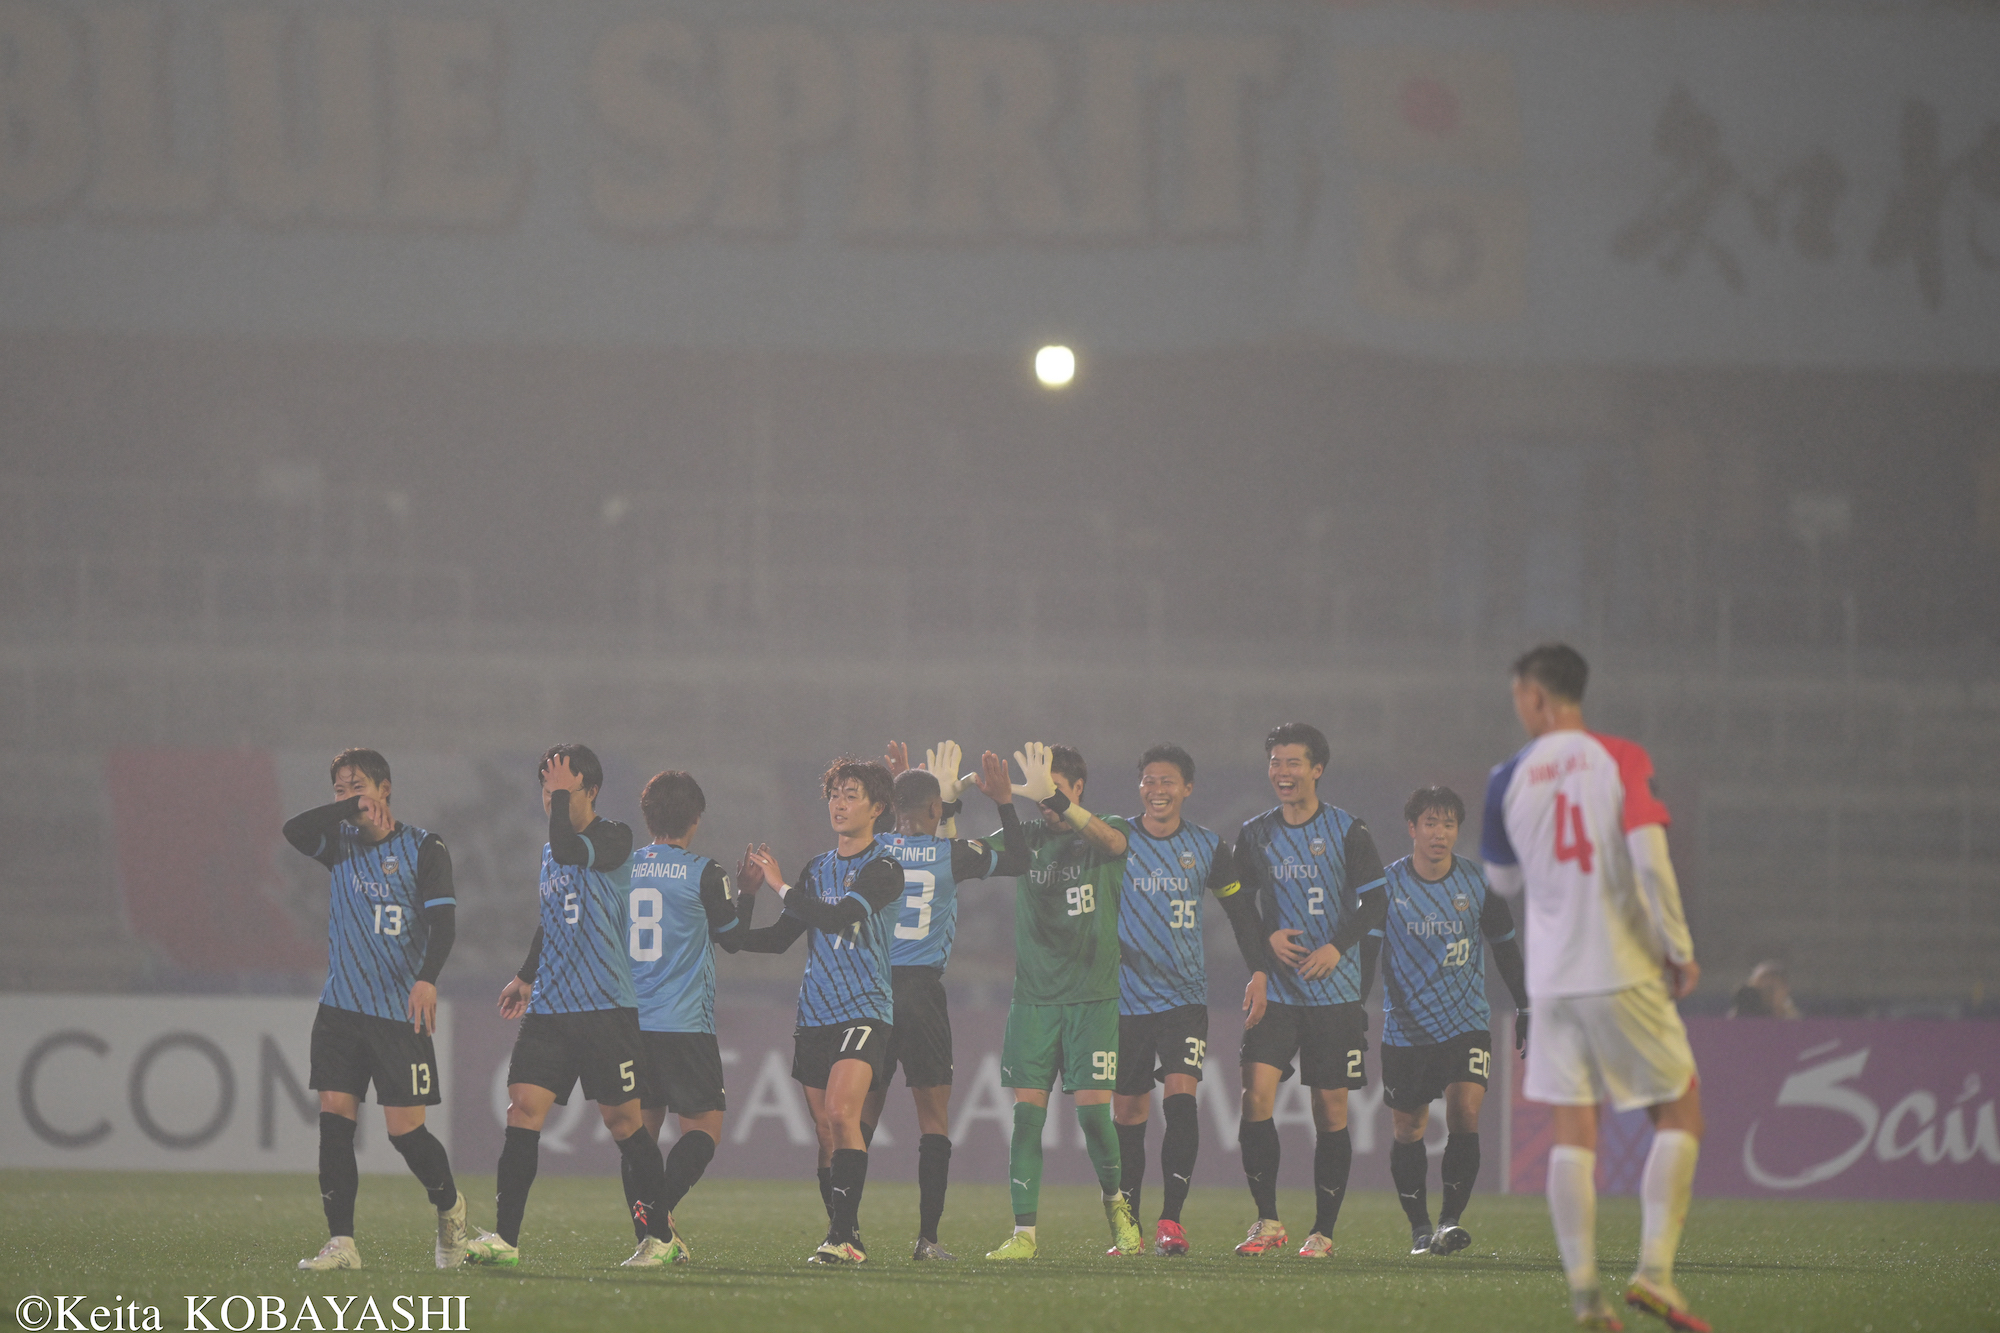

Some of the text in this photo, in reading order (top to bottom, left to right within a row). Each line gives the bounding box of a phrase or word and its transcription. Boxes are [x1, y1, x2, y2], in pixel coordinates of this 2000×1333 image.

[586, 18, 1298, 245] SPIRIT
[1554, 792, 1594, 874] 4
[630, 862, 687, 880] HIBANADA
[1029, 861, 1081, 886] FUJITSU
[1133, 867, 1189, 895] FUJITSU
[1268, 855, 1318, 883] FUJITSU
[564, 892, 579, 924] 5
[1065, 883, 1095, 916] 98
[1169, 899, 1197, 929] 35
[1308, 887, 1324, 915] 2
[374, 904, 402, 936] 13
[629, 887, 662, 962] 8
[1406, 912, 1463, 940] FUJITSU
[1442, 938, 1470, 968] 20
[840, 1025, 872, 1054] 77
[619, 1060, 635, 1092] 5
[1092, 1051, 1117, 1080] 98
[1346, 1049, 1362, 1078] 2
[1468, 1047, 1491, 1079] 20
[410, 1063, 431, 1096] 13
